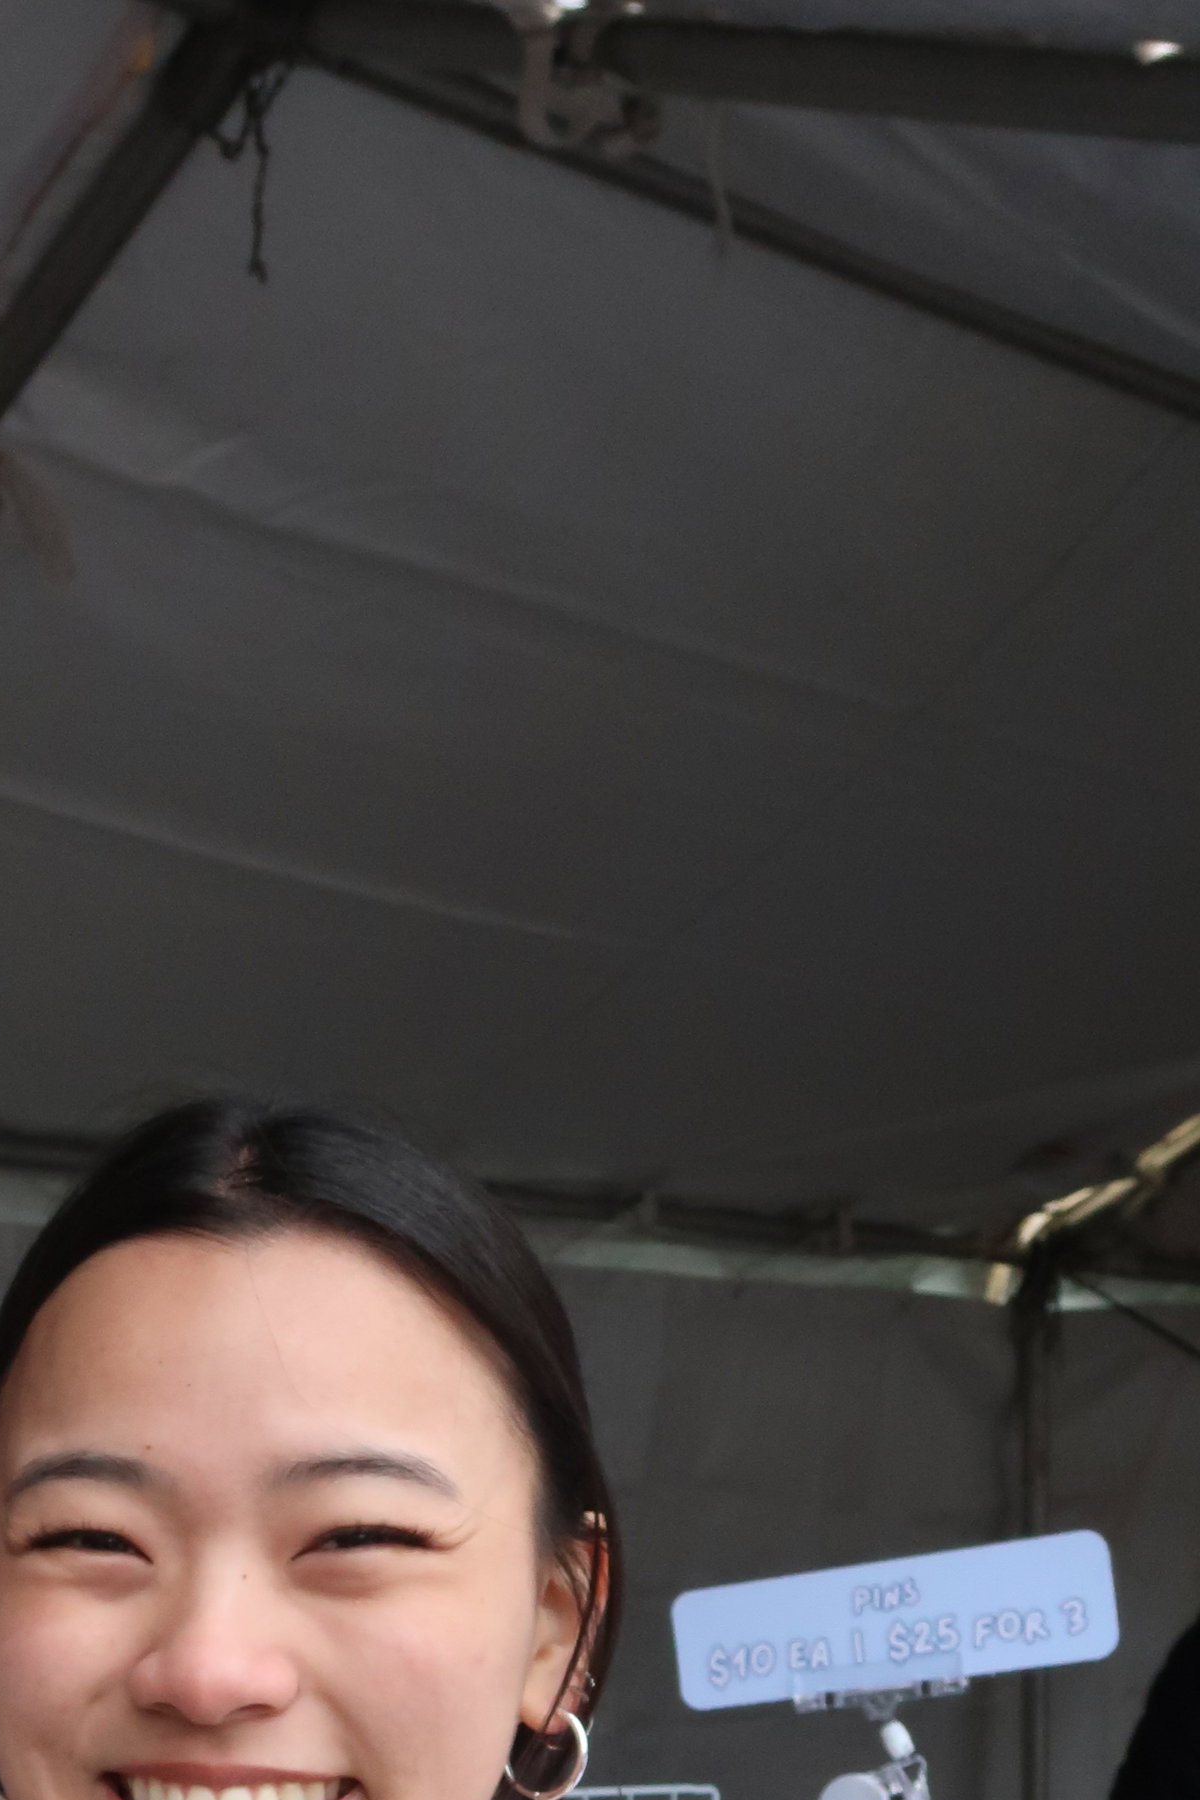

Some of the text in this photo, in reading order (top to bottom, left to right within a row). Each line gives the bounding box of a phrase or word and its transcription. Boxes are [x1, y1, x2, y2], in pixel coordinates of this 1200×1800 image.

[853, 1578, 920, 1614] PINS
[707, 1644, 775, 1690] $10
[789, 1638, 831, 1669] EA
[887, 1615, 960, 1663] $25
[973, 1608, 1048, 1648] FOR
[1060, 1599, 1089, 1635] 3
